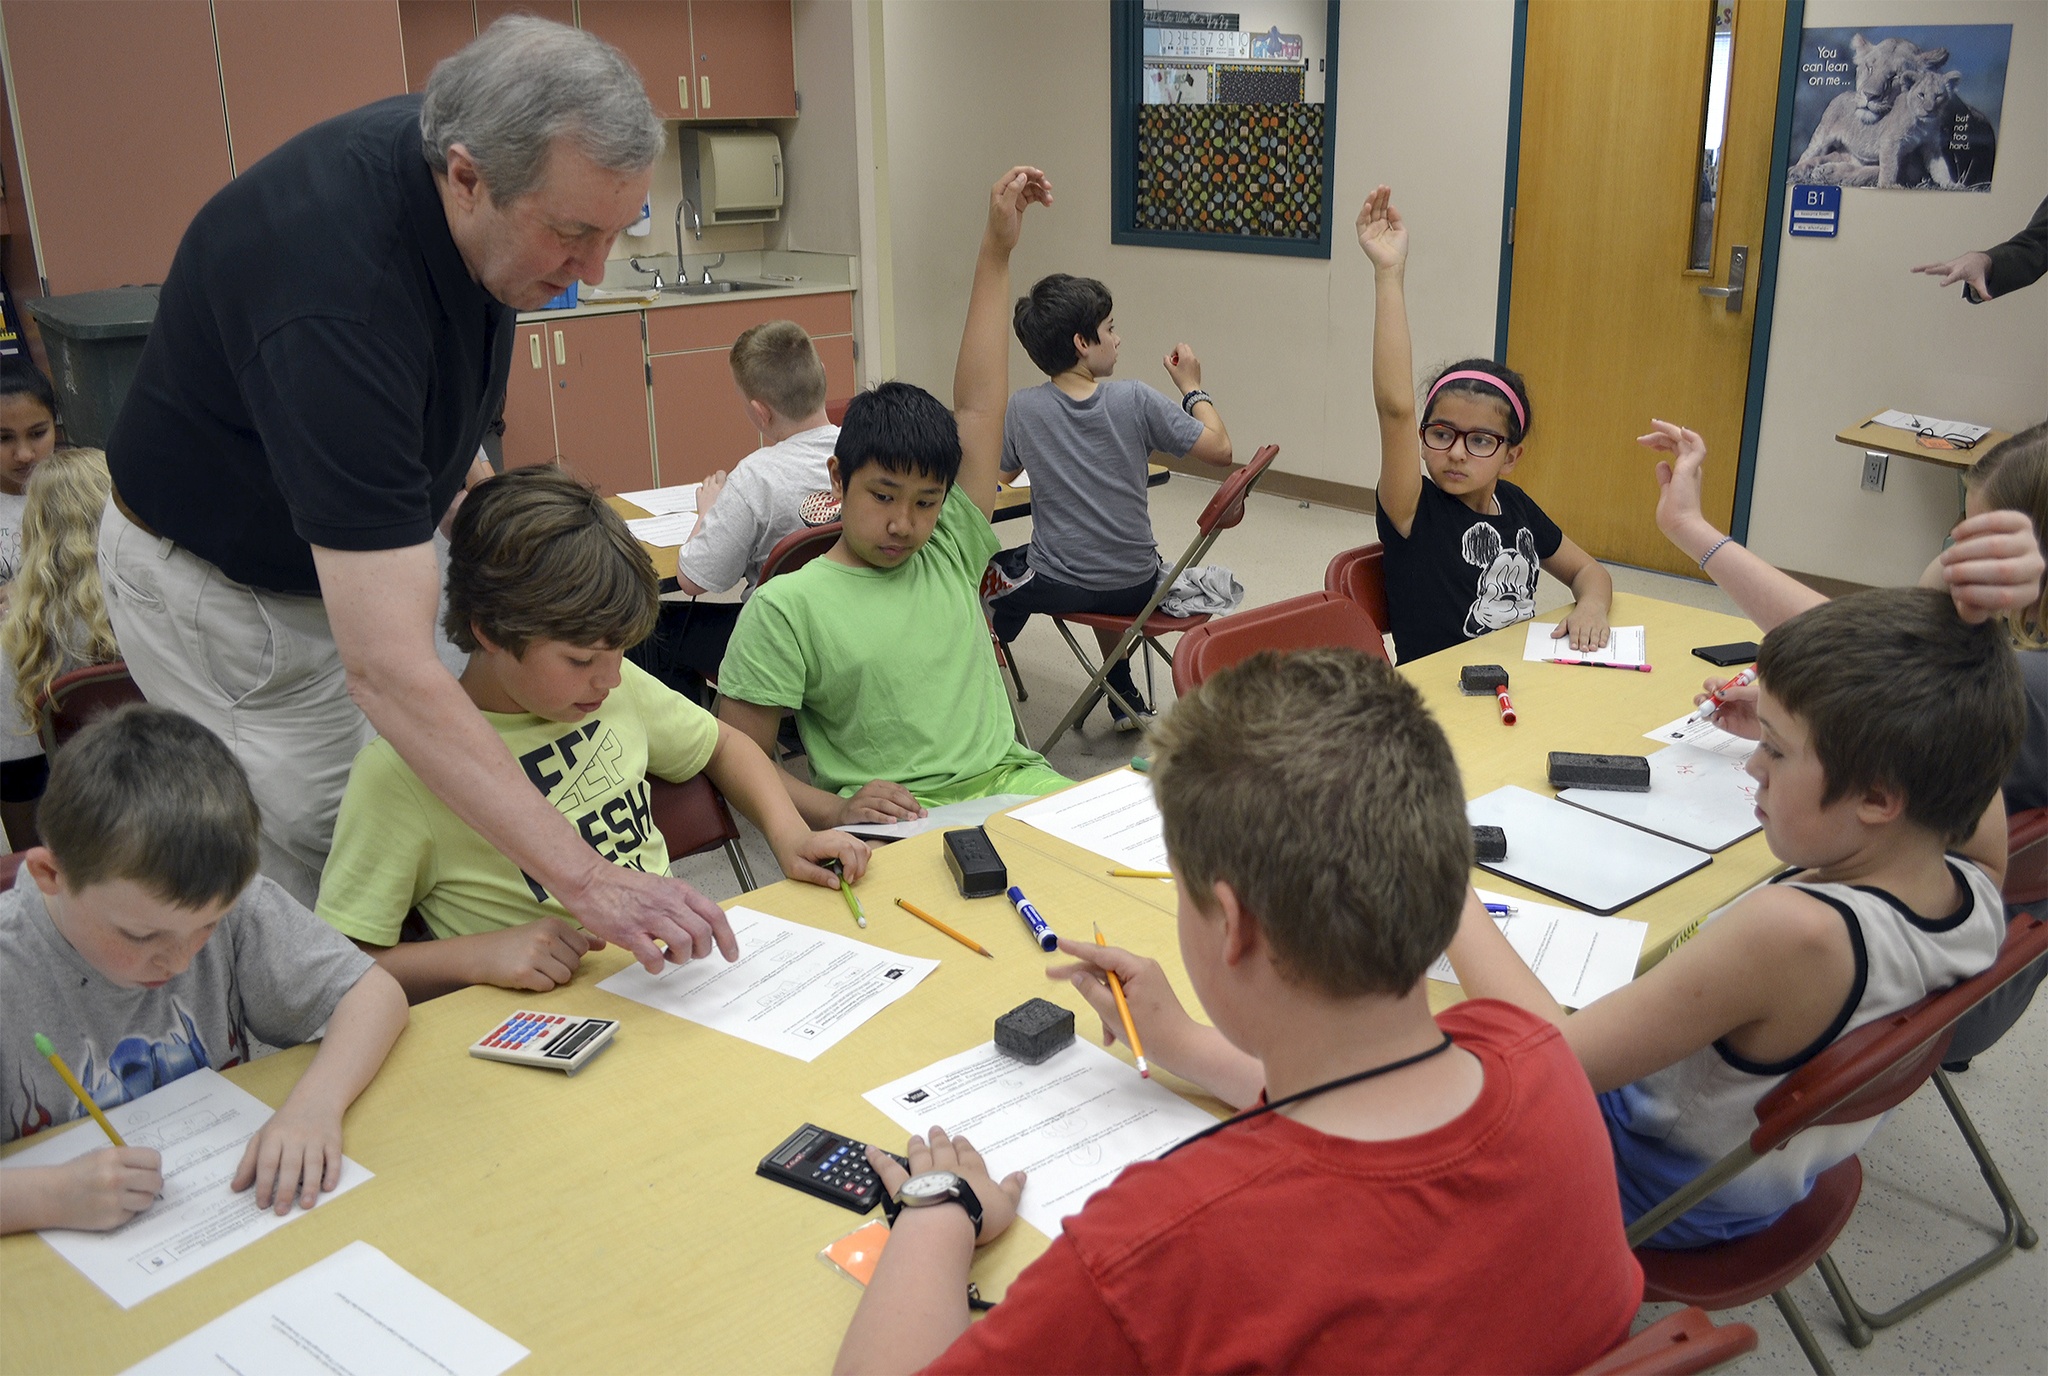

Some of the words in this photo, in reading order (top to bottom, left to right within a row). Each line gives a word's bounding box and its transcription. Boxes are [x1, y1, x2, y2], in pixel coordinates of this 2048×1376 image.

[1168, 30, 1174, 46] 2
[1176, 30, 1182, 46] 3
[1183, 31, 1189, 46] 4
[1191, 32, 1197, 46] 5
[1199, 32, 1206, 46] 6
[1208, 32, 1214, 46] 7
[1218, 33, 1225, 47] 8
[1228, 33, 1234, 46] 9
[1238, 32, 1249, 47] 10
[1817, 46, 1837, 59] You
[1802, 63, 1823, 72] can
[1825, 60, 1849, 72] lean
[1808, 76, 1823, 85] on
[1955, 114, 1969, 122] but
[1953, 123, 1968, 131] not
[1953, 132, 1968, 141] too
[1807, 190, 1825, 206] B1
